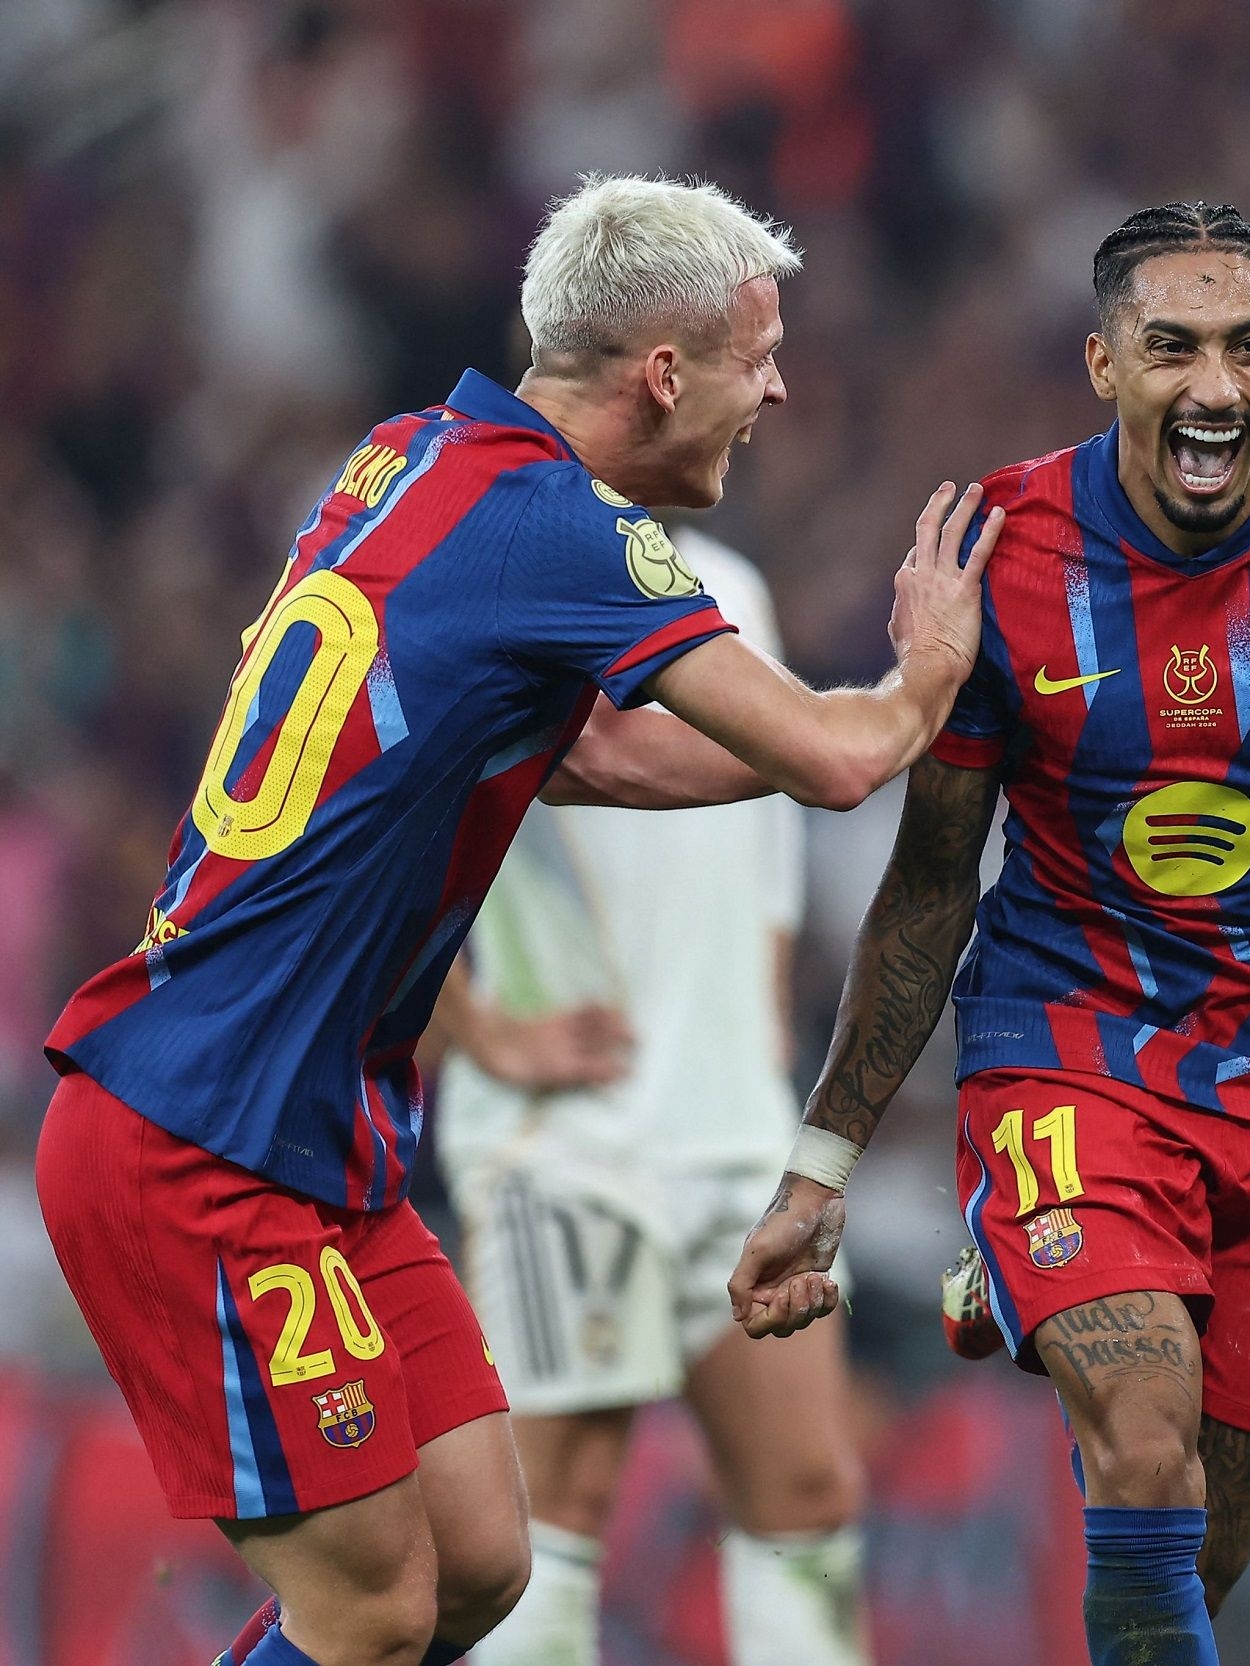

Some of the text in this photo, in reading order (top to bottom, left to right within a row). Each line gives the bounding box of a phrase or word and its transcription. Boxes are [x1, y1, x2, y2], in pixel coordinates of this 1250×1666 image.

[335, 444, 408, 509] OLMO
[191, 556, 379, 861] 0
[1160, 708, 1223, 717] SUPERCOPA
[991, 1105, 1085, 1218] 11
[547, 1195, 645, 1296] 17
[248, 1245, 385, 1387] 20
[336, 1409, 358, 1422] FCB
